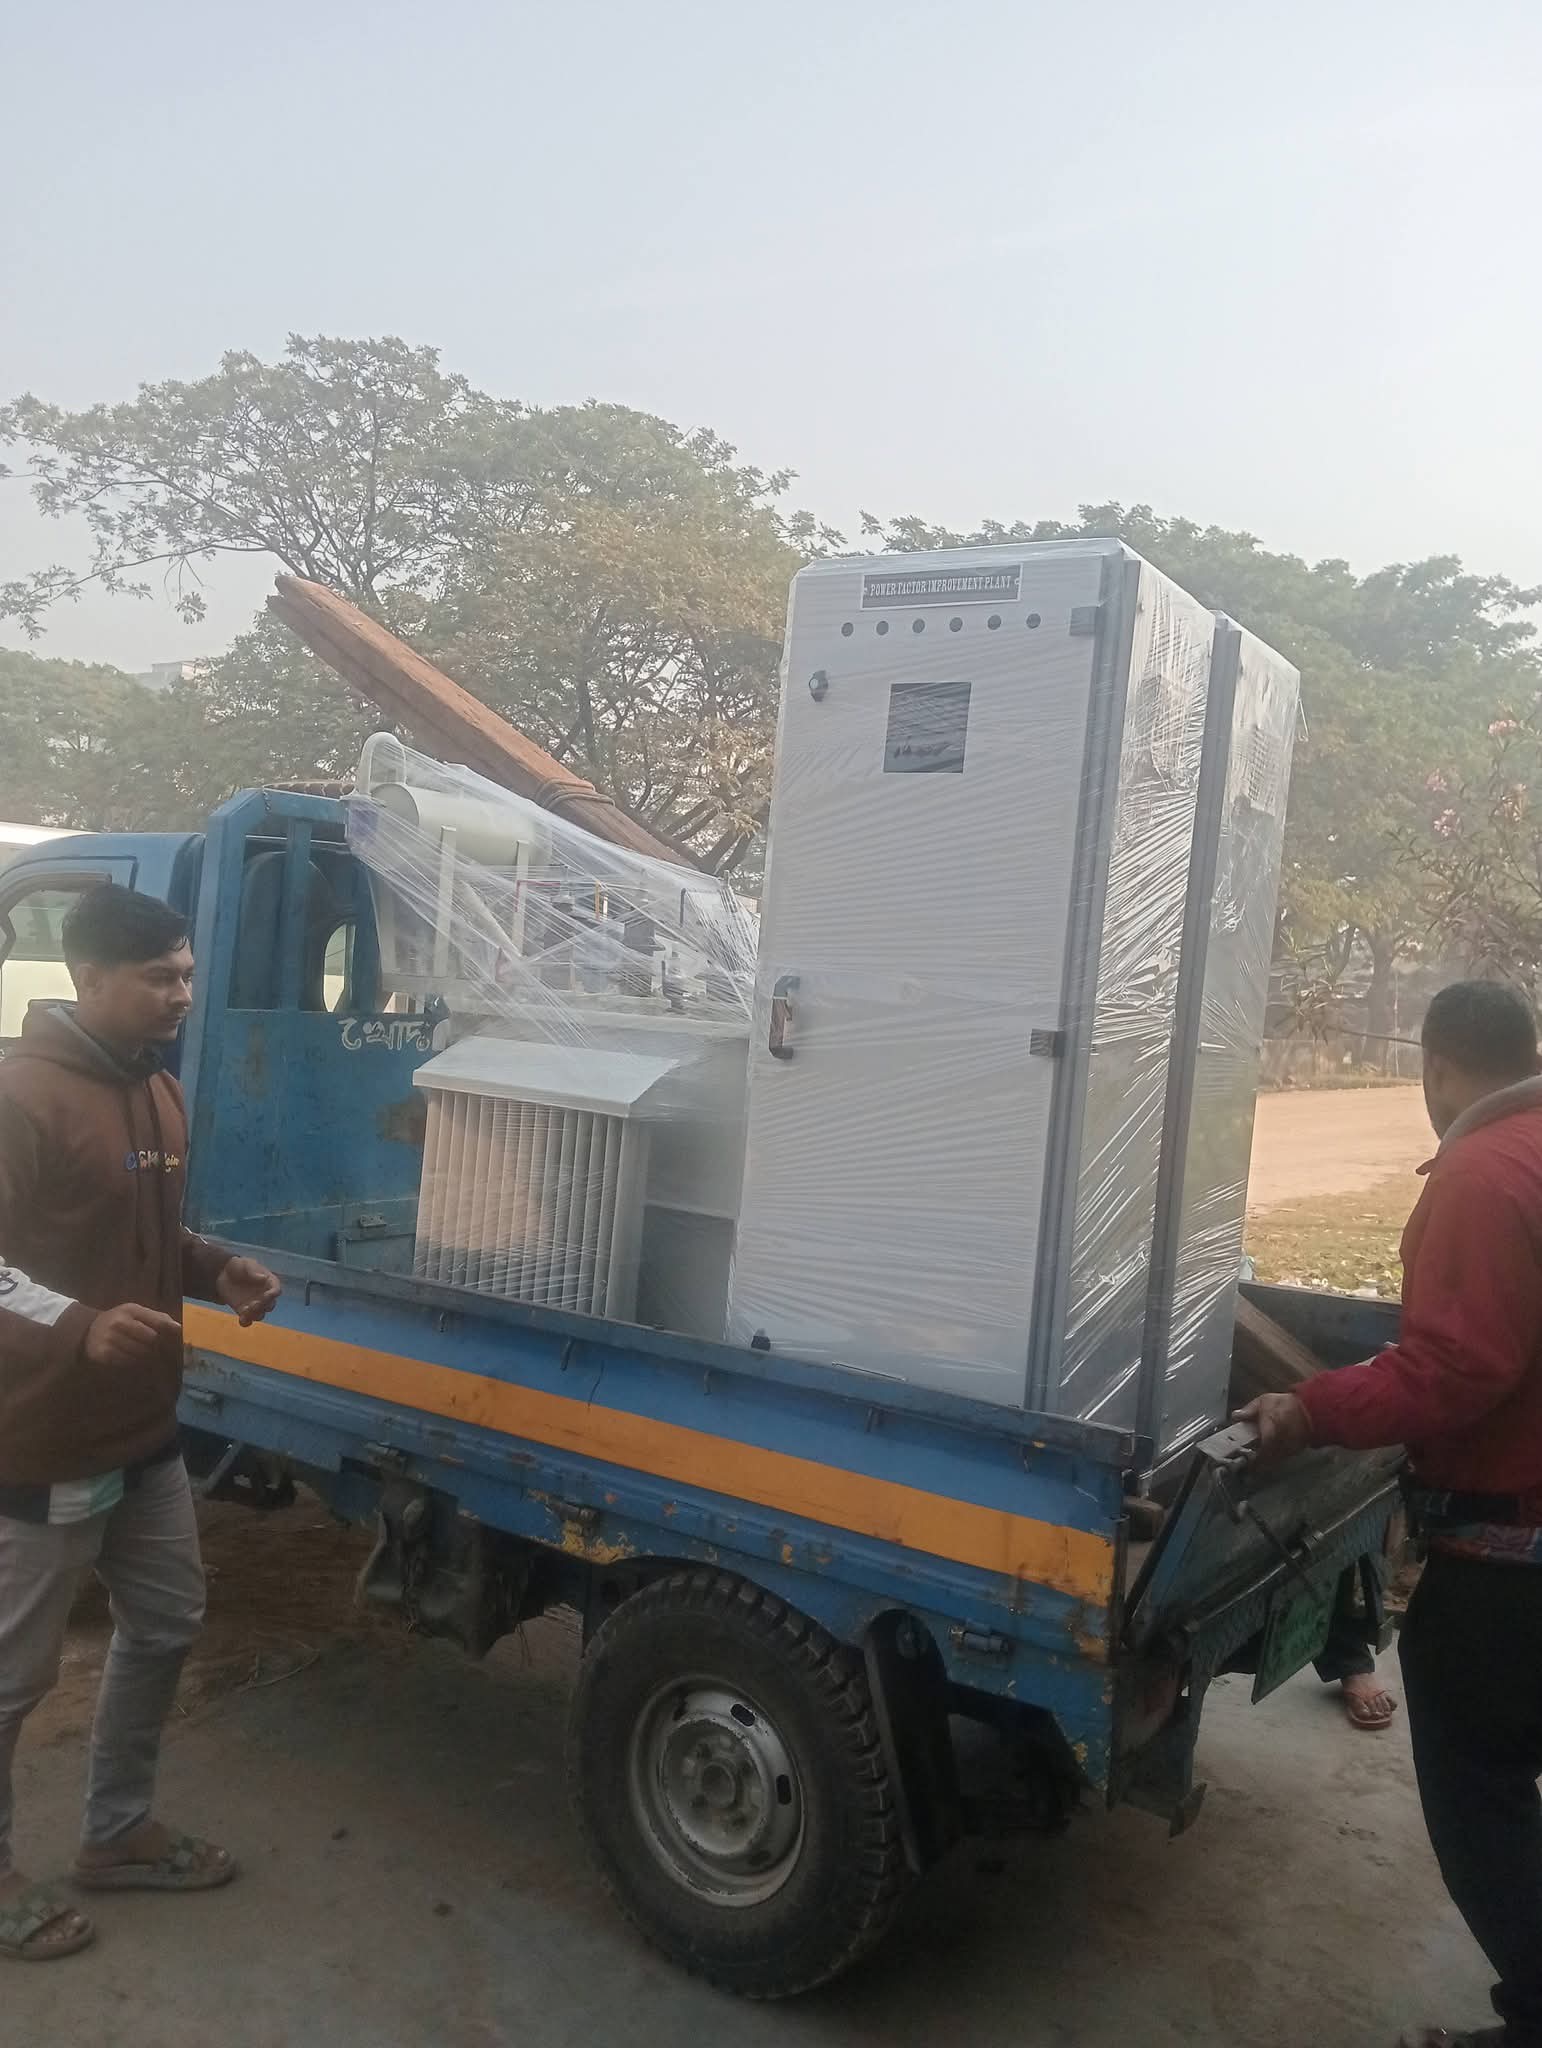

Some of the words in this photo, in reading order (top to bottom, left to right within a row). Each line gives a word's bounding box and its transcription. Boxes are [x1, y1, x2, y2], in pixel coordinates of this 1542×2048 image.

[870, 582, 897, 597] POWER
[897, 580, 927, 595] FACTOR
[928, 576, 984, 593] IMPROVEMENT
[985, 575, 1012, 589] PLANT
